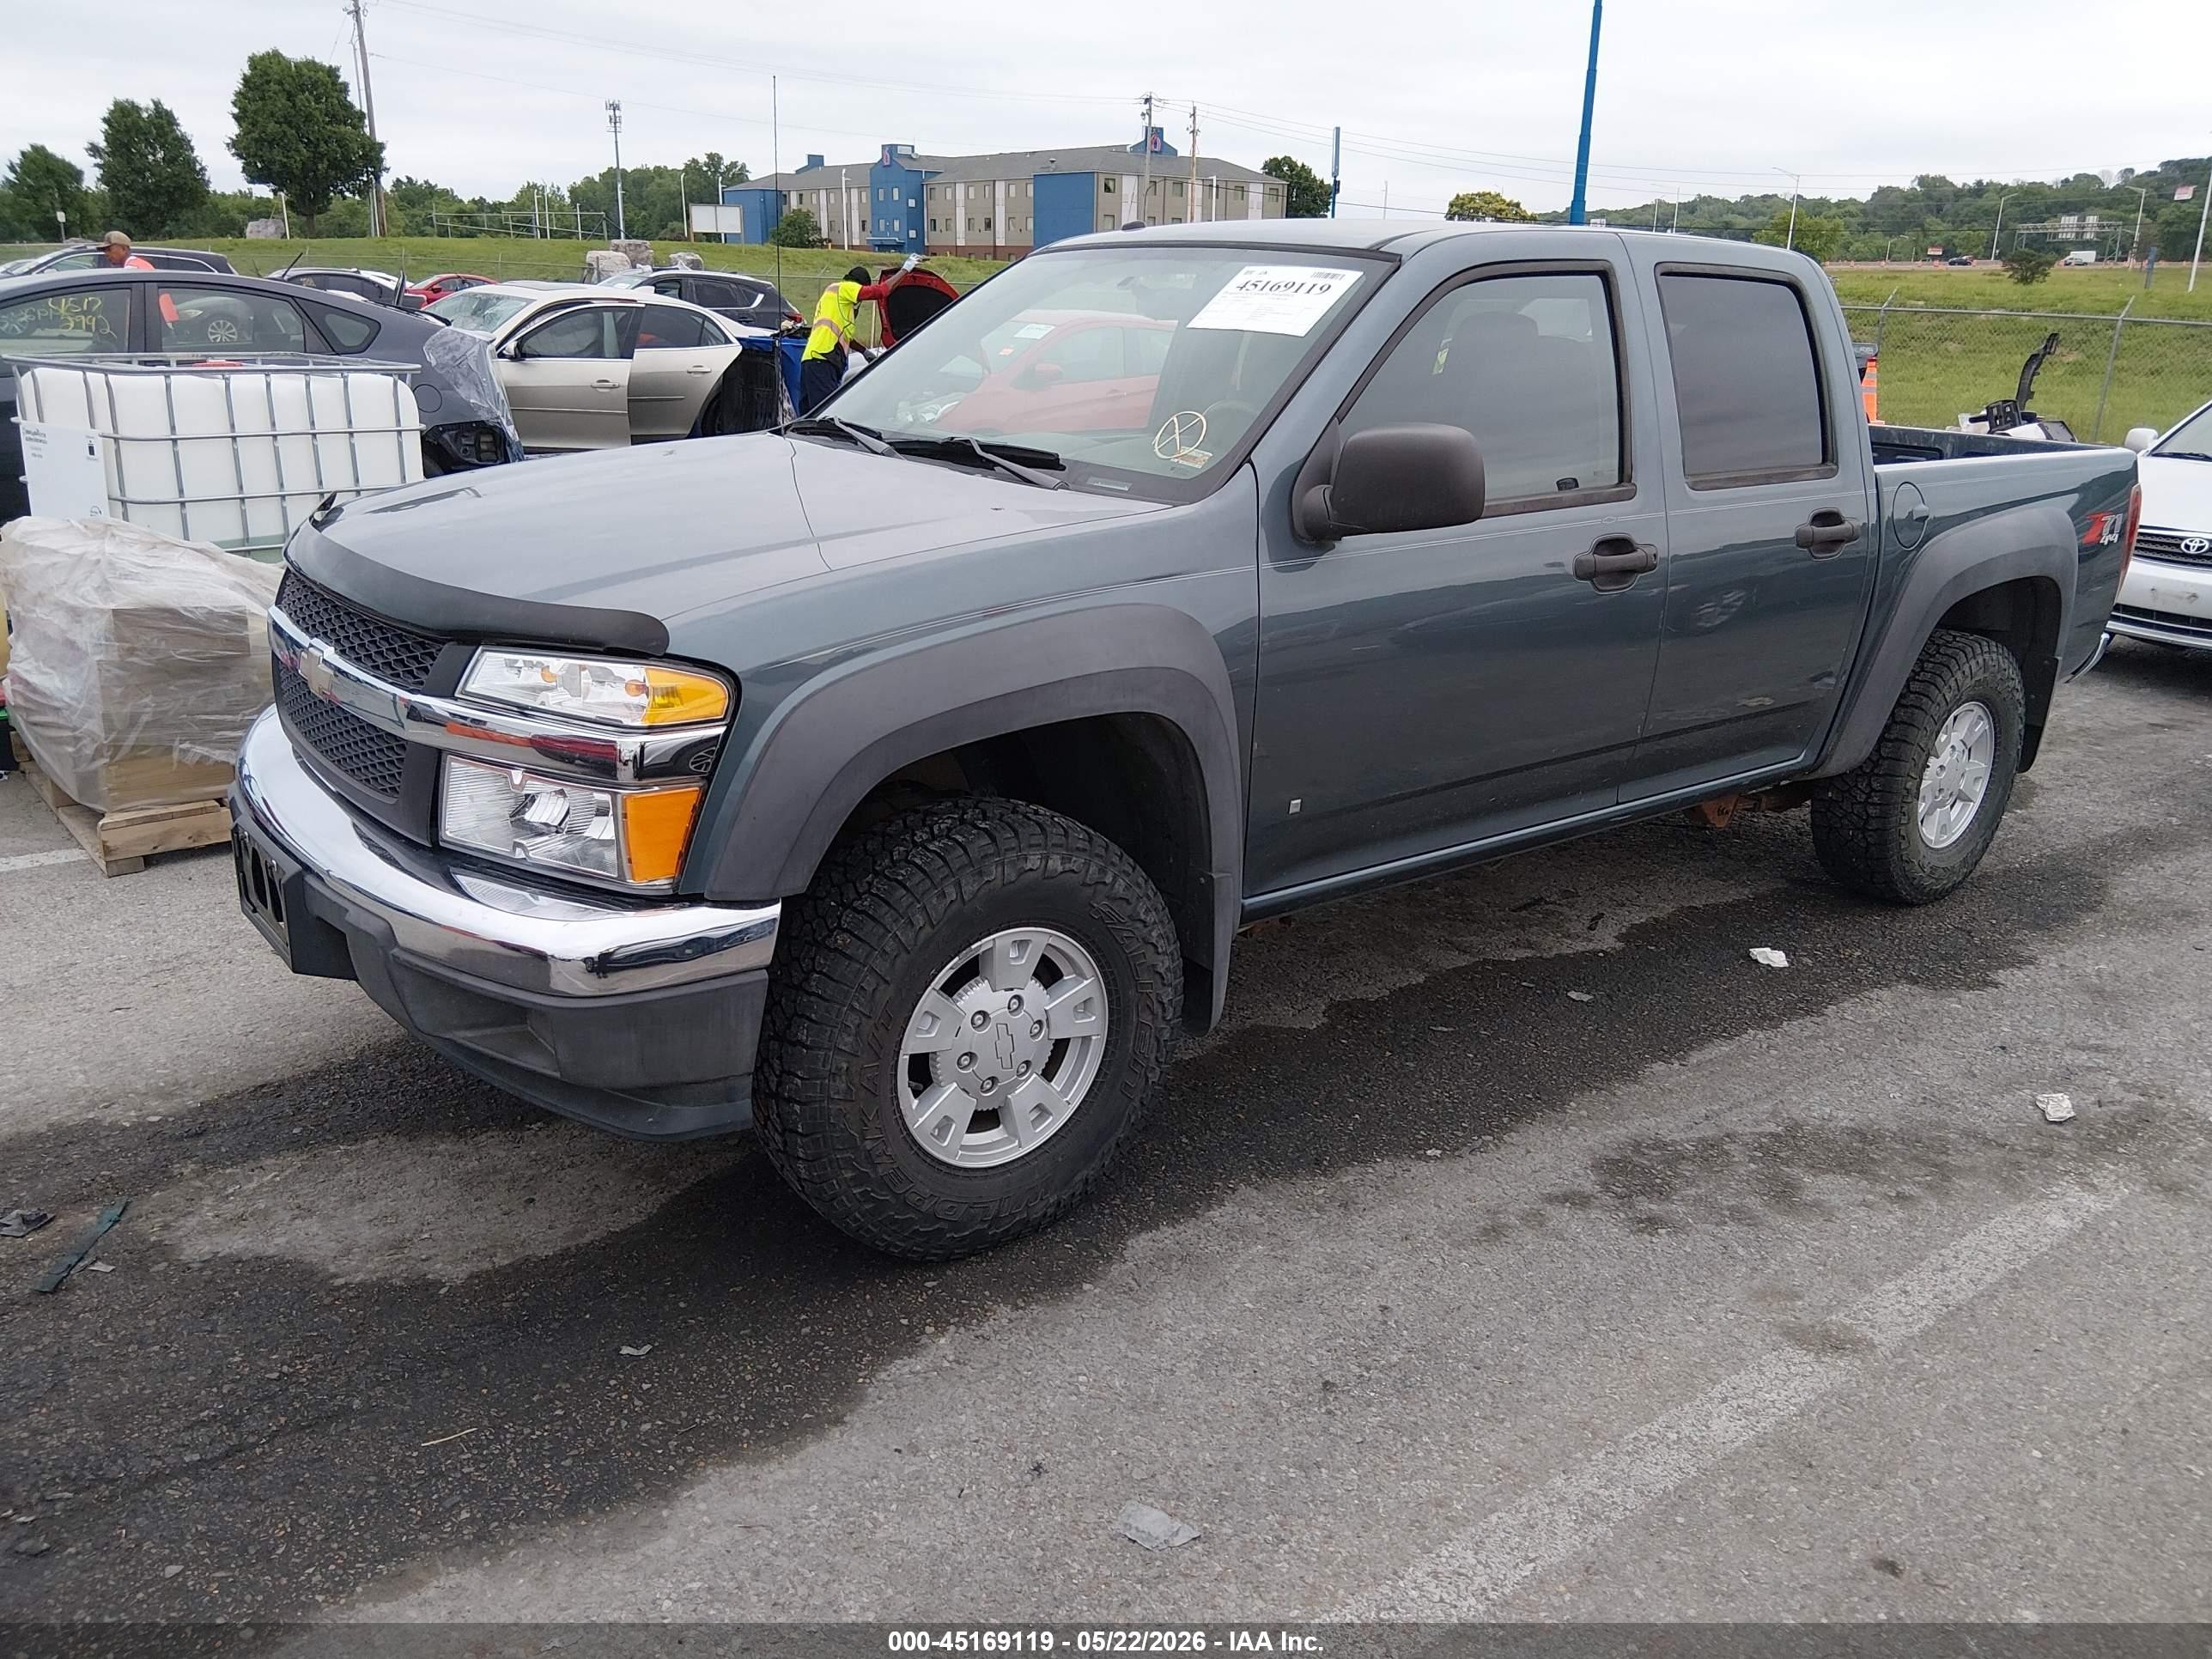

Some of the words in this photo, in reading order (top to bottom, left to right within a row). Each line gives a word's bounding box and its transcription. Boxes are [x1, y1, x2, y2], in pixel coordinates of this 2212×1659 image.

[1236, 279, 1332, 295] 45169119
[2081, 512, 2124, 545] Z71
[1089, 900, 1156, 1101] FALKEN
